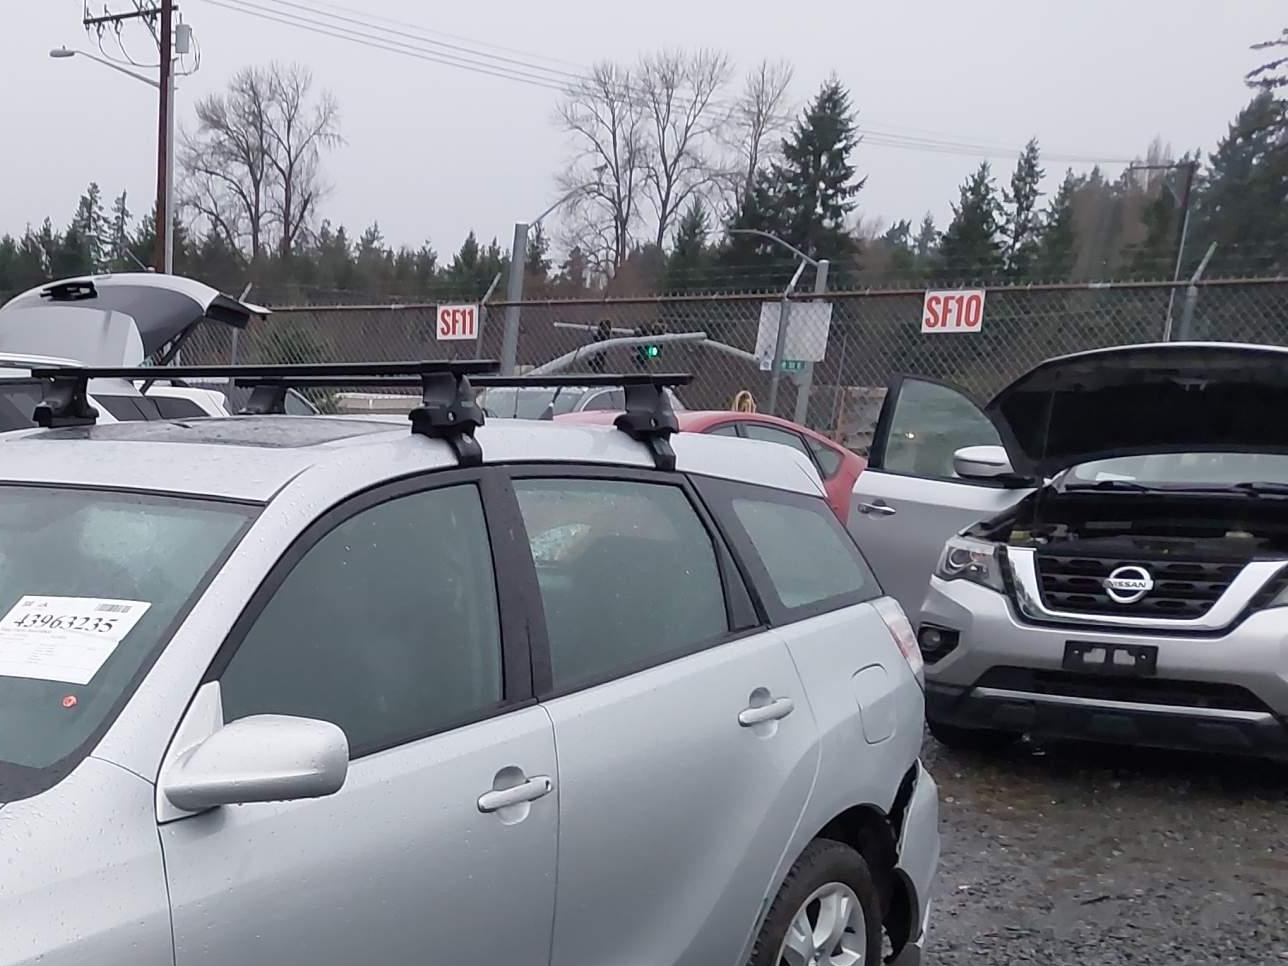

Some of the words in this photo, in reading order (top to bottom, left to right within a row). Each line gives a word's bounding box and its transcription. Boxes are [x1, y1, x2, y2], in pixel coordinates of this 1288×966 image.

[440, 309, 474, 336] SF11
[925, 295, 982, 328] SF10
[1109, 580, 1146, 588] NISSAN
[14, 613, 120, 633] 43963235
